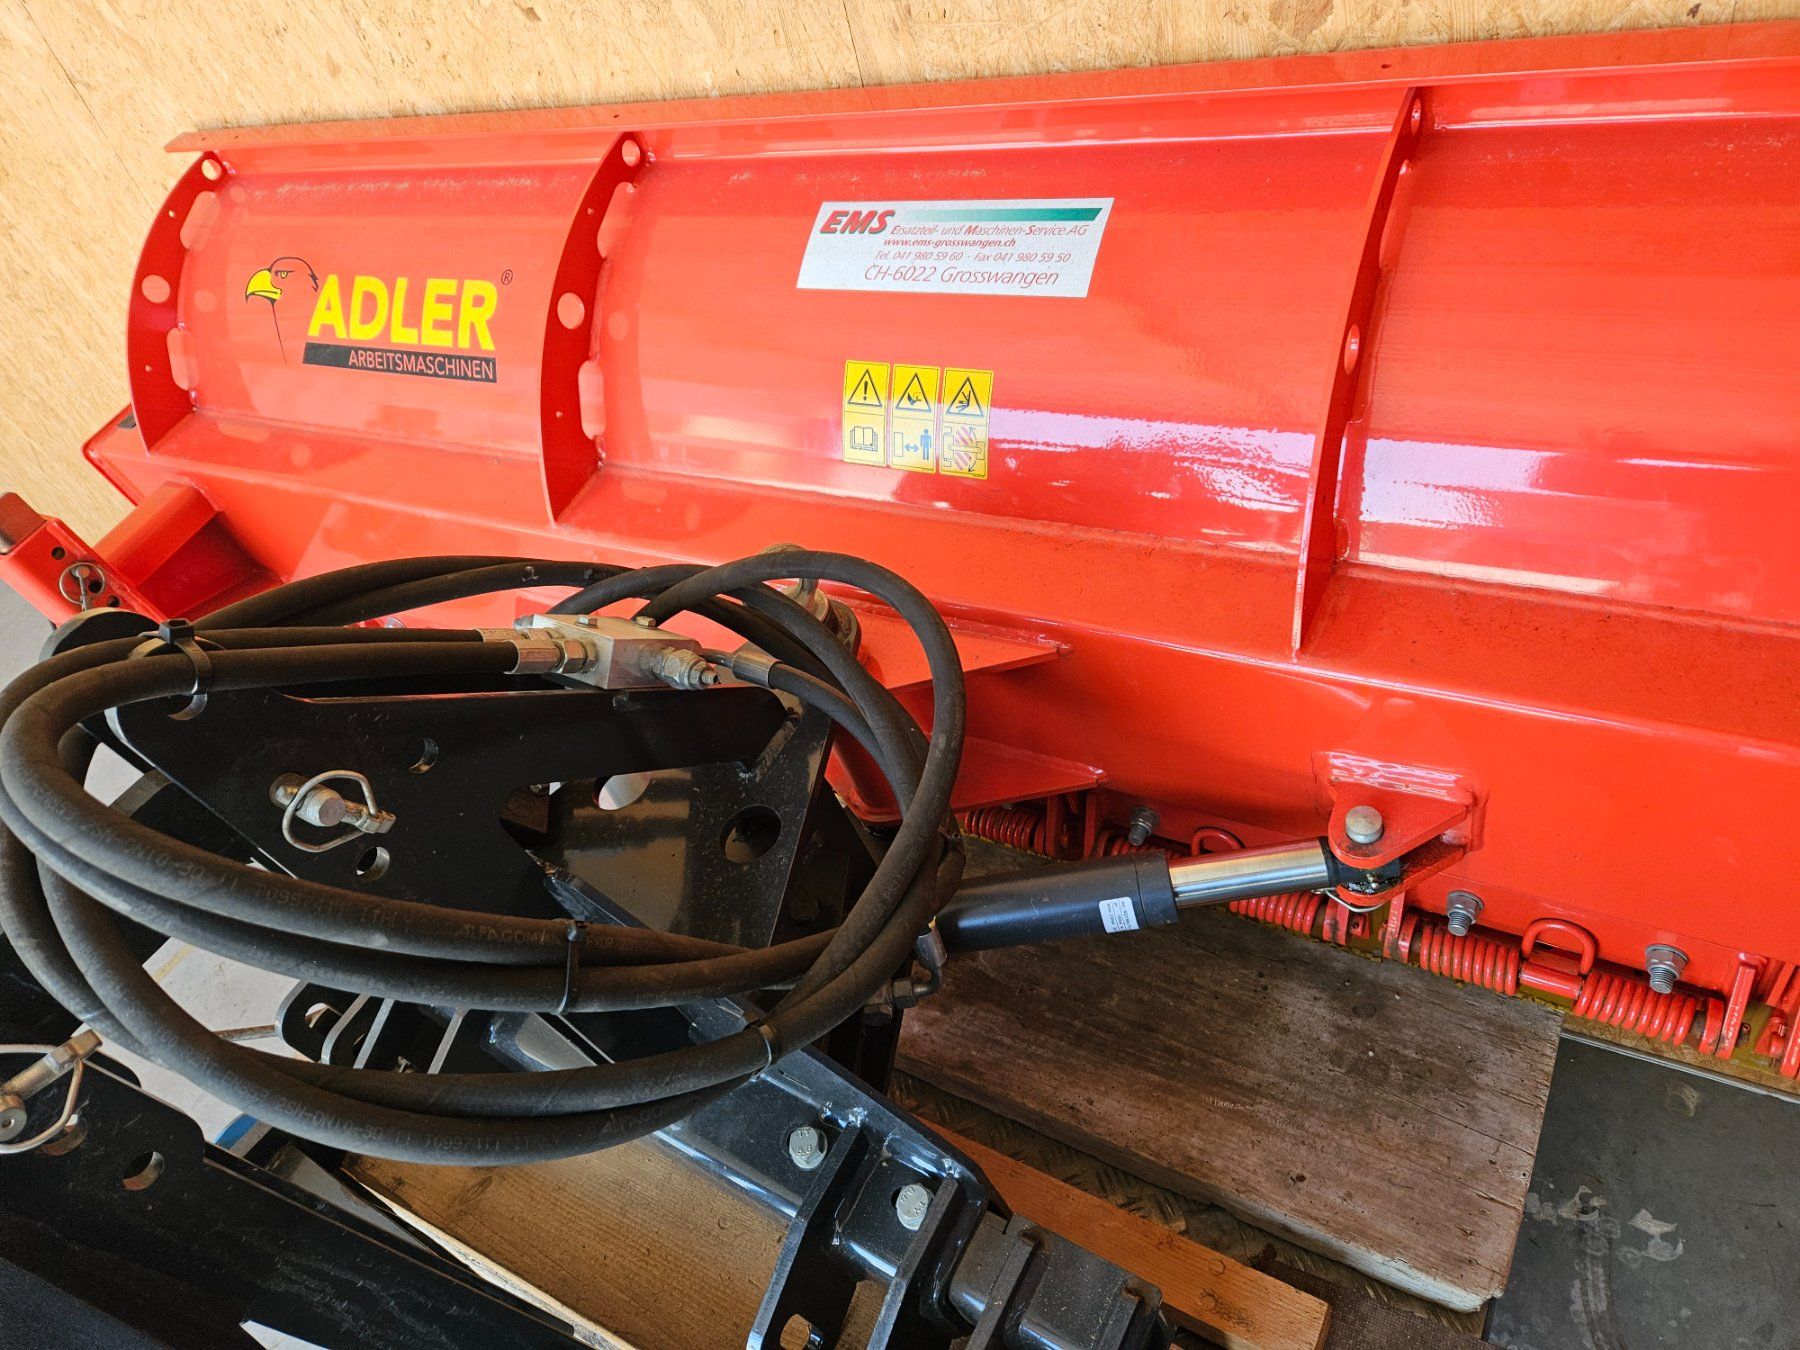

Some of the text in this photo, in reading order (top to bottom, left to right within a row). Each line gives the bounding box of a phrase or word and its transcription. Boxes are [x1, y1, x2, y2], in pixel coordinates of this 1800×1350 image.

[819, 209, 896, 235] EMS
[890, 225, 1090, 236] Ersatzteil- und Maschinen-Service AG
[883, 238, 1017, 249] www.ems-grosswangen.ch
[874, 250, 1072, 263] Tel. 041 980 59 60 Fax 041 980 59 50
[864, 264, 1060, 289] CH-6022 Grosswangen
[307, 273, 498, 351] ADLER
[348, 349, 494, 380] ARBEITSMASCHINEN
